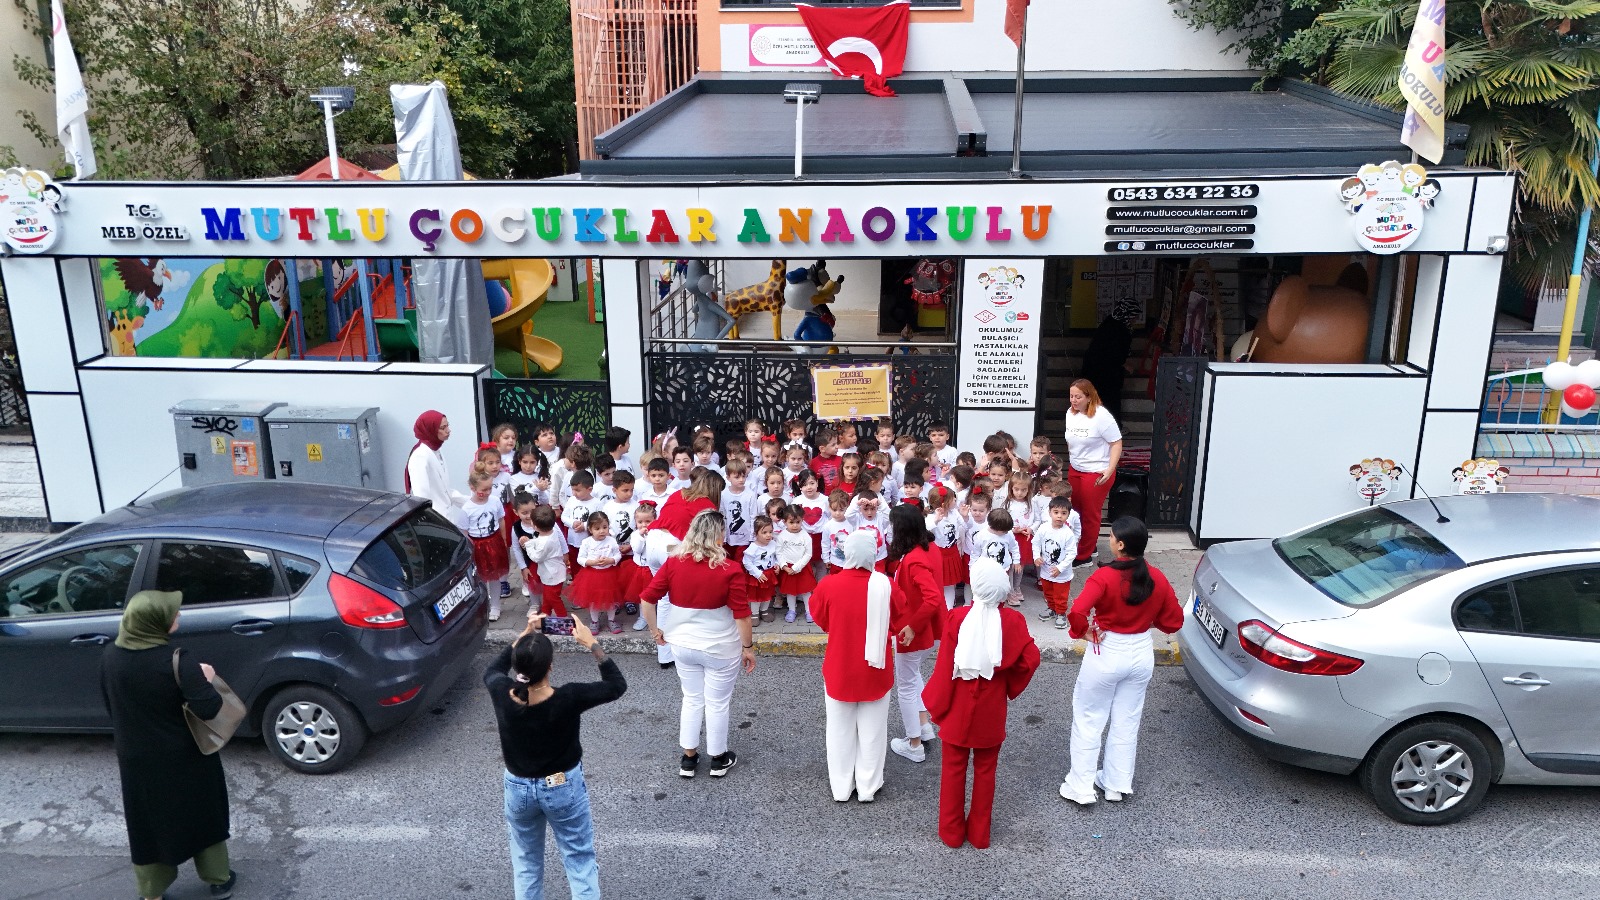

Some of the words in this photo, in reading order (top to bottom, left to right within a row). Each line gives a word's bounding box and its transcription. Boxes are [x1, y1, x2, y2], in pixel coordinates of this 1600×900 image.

[1113, 187, 1158, 200] 0543
[1163, 186, 1198, 199] 634
[1202, 186, 1225, 198] 22
[1230, 185, 1253, 198] 36
[125, 204, 156, 217] T.C.
[1115, 208, 1249, 217] www.mutlucocuklar.com.tr
[1376, 215, 1404, 224] MUTLU
[101, 226, 136, 239] MEB
[142, 223, 184, 239] ÖZEL
[201, 207, 390, 242] MUTLU
[408, 207, 717, 251] ÇOCUKLAR
[737, 205, 1053, 242] ANAOKULU
[1113, 225, 1247, 235] mutlucocuklar@gmail.com
[1155, 241, 1235, 250] mutlucocuklar
[972, 373, 989, 381] İÇİN
[438, 599, 450, 615] 35
[447, 586, 463, 607] UHC
[461, 579, 471, 595] 79
